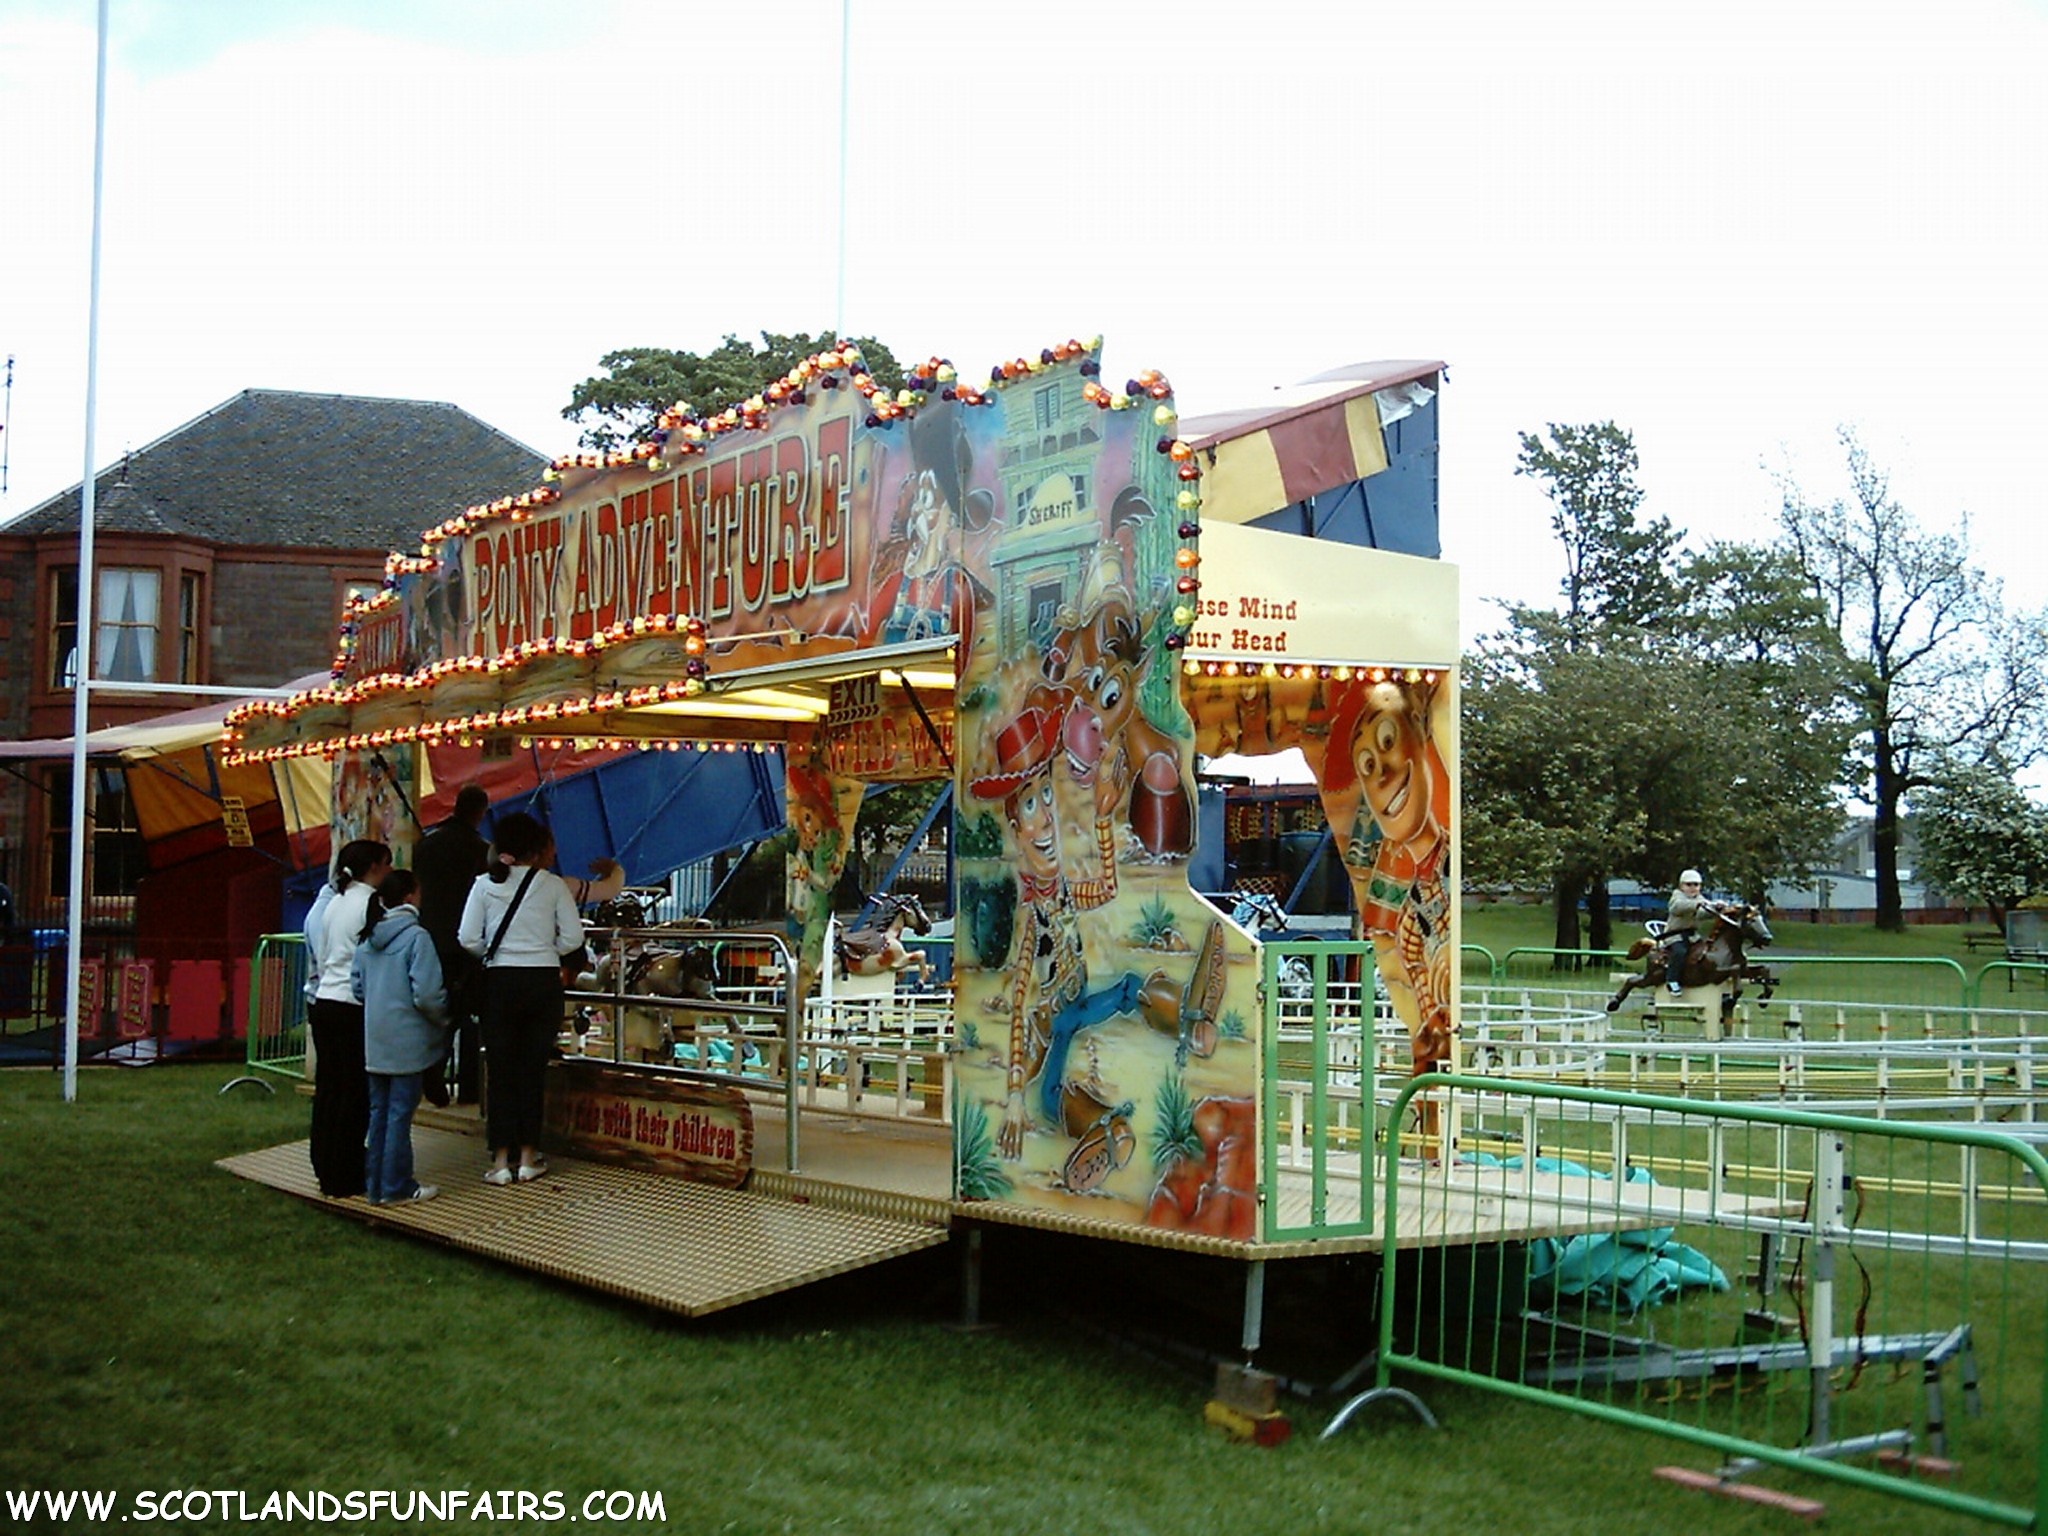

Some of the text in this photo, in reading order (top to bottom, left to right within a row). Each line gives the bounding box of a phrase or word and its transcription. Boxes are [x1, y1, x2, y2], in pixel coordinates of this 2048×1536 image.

[1028, 500, 1073, 526] SHERIFF
[473, 413, 854, 656] PONY ADVENTURE
[1196, 597, 1298, 621] ase Mind
[1187, 629, 1287, 652] our Head
[831, 676, 879, 709] EXIT
[603, 1101, 632, 1139] with
[636, 1105, 669, 1147] their
[672, 1112, 735, 1160] children
